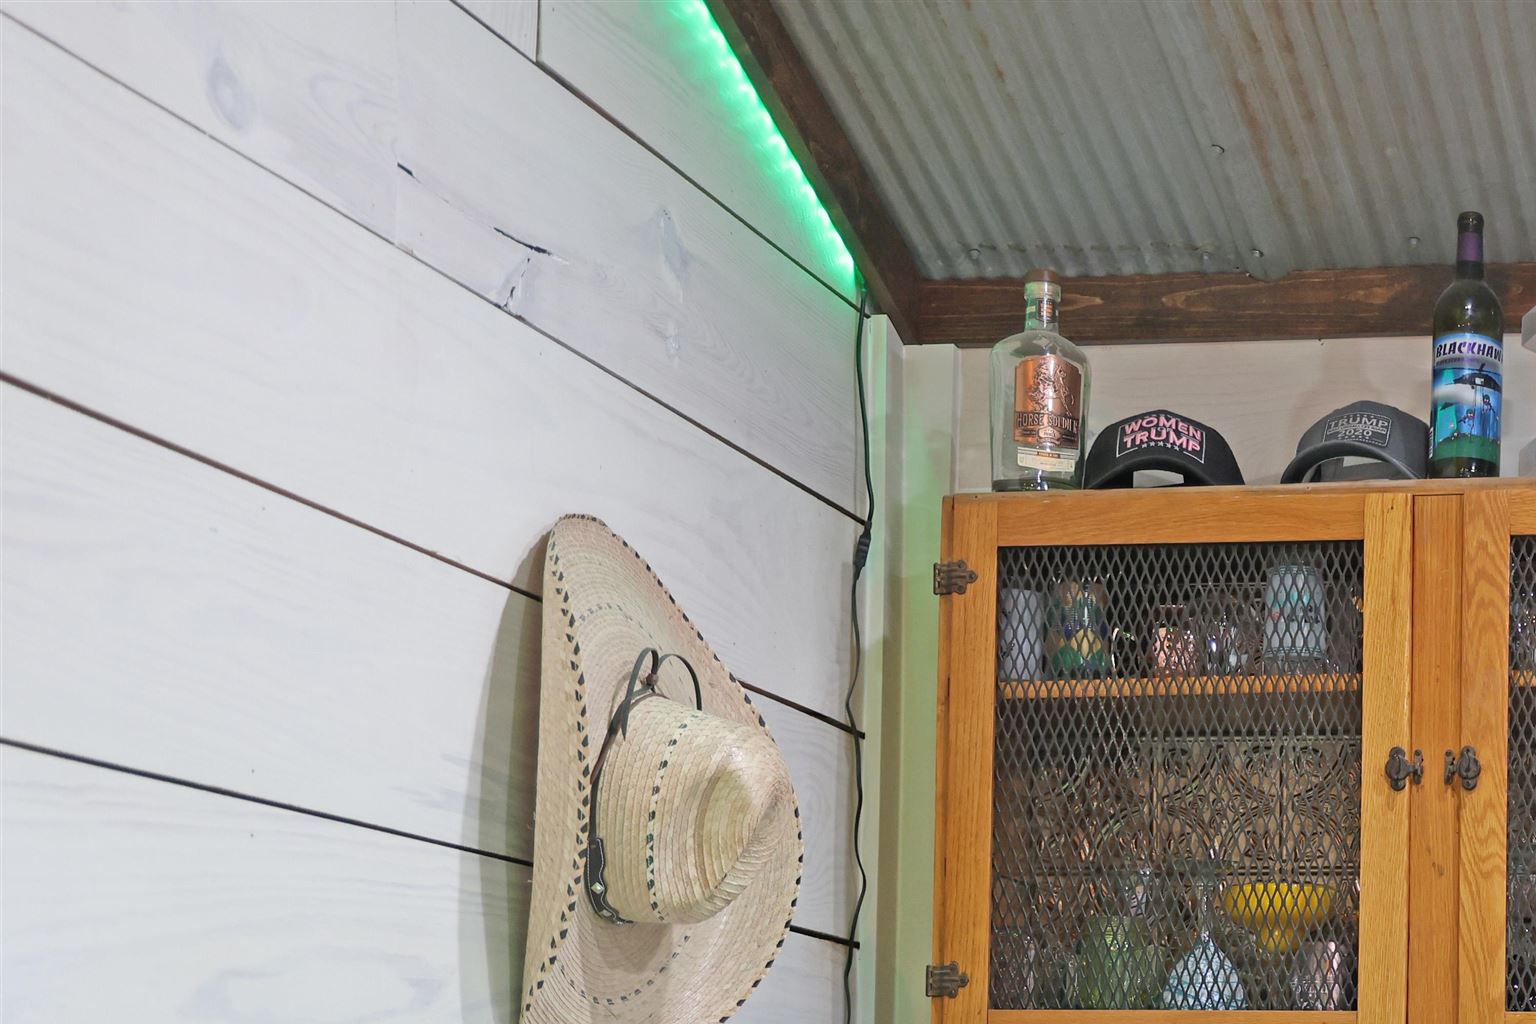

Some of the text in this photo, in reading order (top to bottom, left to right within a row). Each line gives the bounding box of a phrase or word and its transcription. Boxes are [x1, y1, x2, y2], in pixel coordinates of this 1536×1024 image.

[1436, 341, 1503, 364] BLACKHAW
[1016, 411, 1044, 427] HORSE
[1124, 416, 1201, 441] WOMEN
[1329, 417, 1388, 430] TRUMP
[1123, 427, 1201, 452] TRUMP
[1337, 429, 1372, 438] 2020
